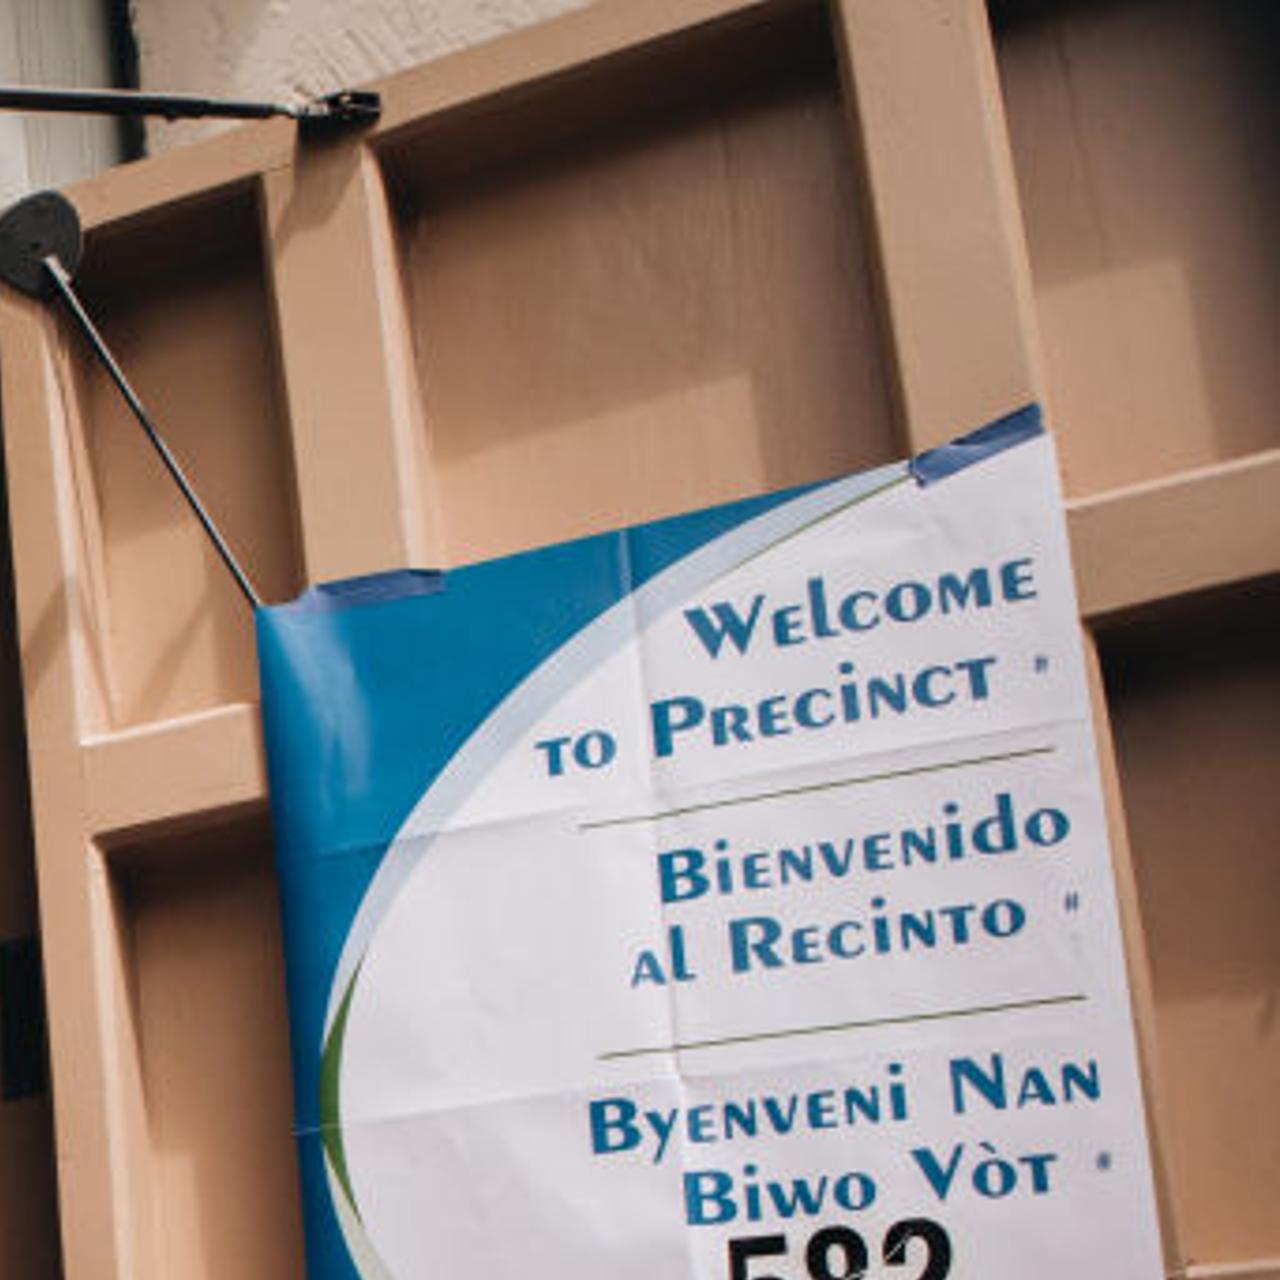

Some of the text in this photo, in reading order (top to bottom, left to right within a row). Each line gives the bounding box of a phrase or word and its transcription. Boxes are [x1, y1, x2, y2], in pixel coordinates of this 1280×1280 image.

[682, 557, 1039, 660] Welcome
[534, 729, 617, 777] to
[650, 656, 997, 758] Precinct
[656, 792, 1070, 904] Bienvenido
[630, 924, 696, 987] al
[728, 896, 1027, 974] Recinto
[588, 1053, 1102, 1163] Byenveni Nan
[682, 1142, 1058, 1227] Biwo Vòt
